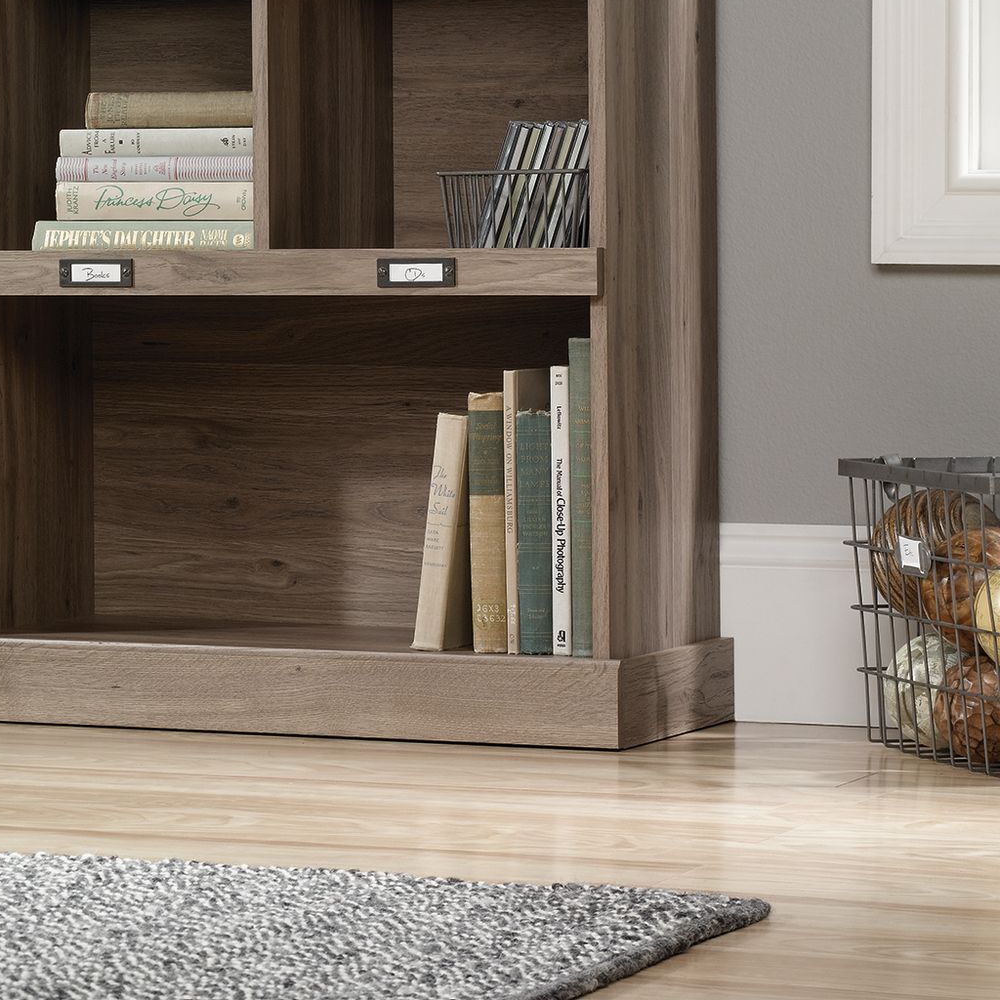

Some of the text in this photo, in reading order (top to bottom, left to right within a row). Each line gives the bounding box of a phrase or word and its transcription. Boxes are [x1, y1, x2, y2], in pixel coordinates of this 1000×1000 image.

[94, 184, 221, 217] Princess Daisy
[43, 228, 195, 249] JEPHTE'S DAUGHTER
[81, 267, 110, 282] Books
[506, 452, 512, 466] ON
[433, 465, 448, 480] The
[430, 482, 456, 499] White
[505, 467, 514, 534] WILLIAMSBURG
[554, 497, 566, 536] Close-Up
[554, 538, 567, 594] Photography
